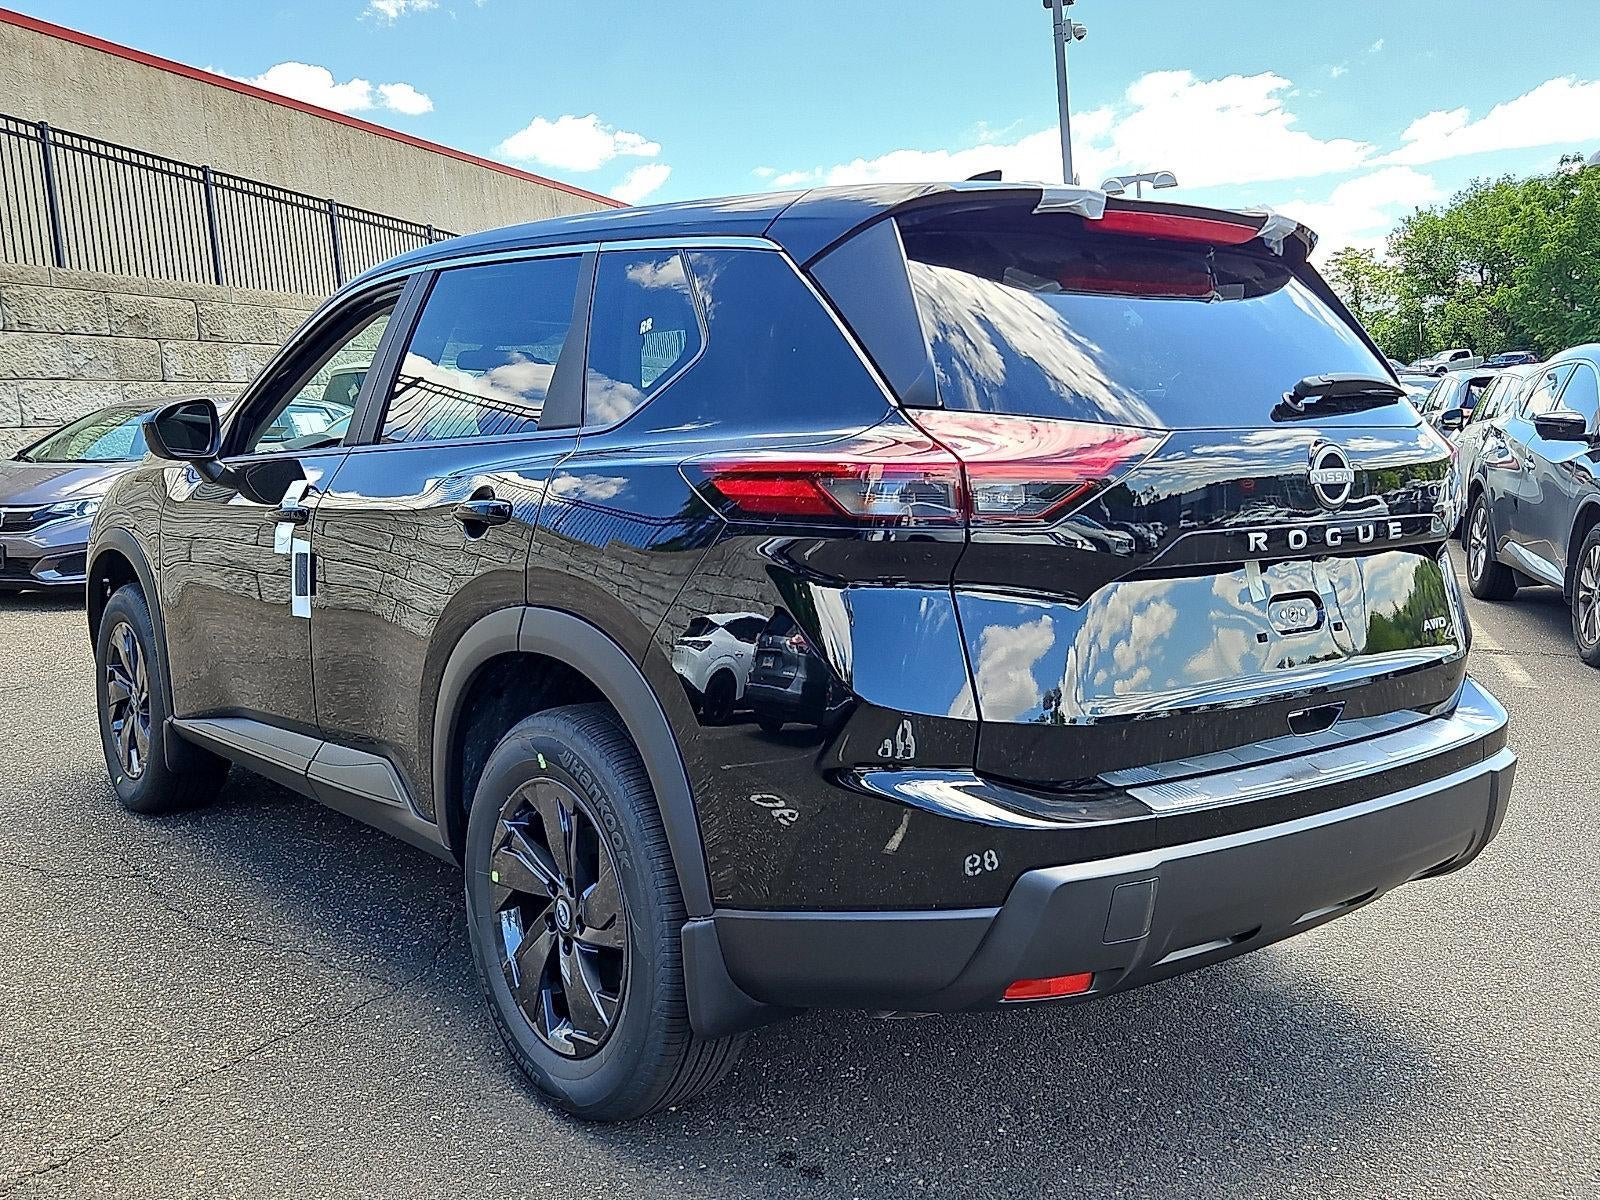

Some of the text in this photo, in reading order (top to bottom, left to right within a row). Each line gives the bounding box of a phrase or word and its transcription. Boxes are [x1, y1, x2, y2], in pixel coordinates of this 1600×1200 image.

[1312, 470, 1354, 483] NISSAN
[1248, 521, 1403, 552] ROGUE
[1423, 616, 1447, 632] AWD
